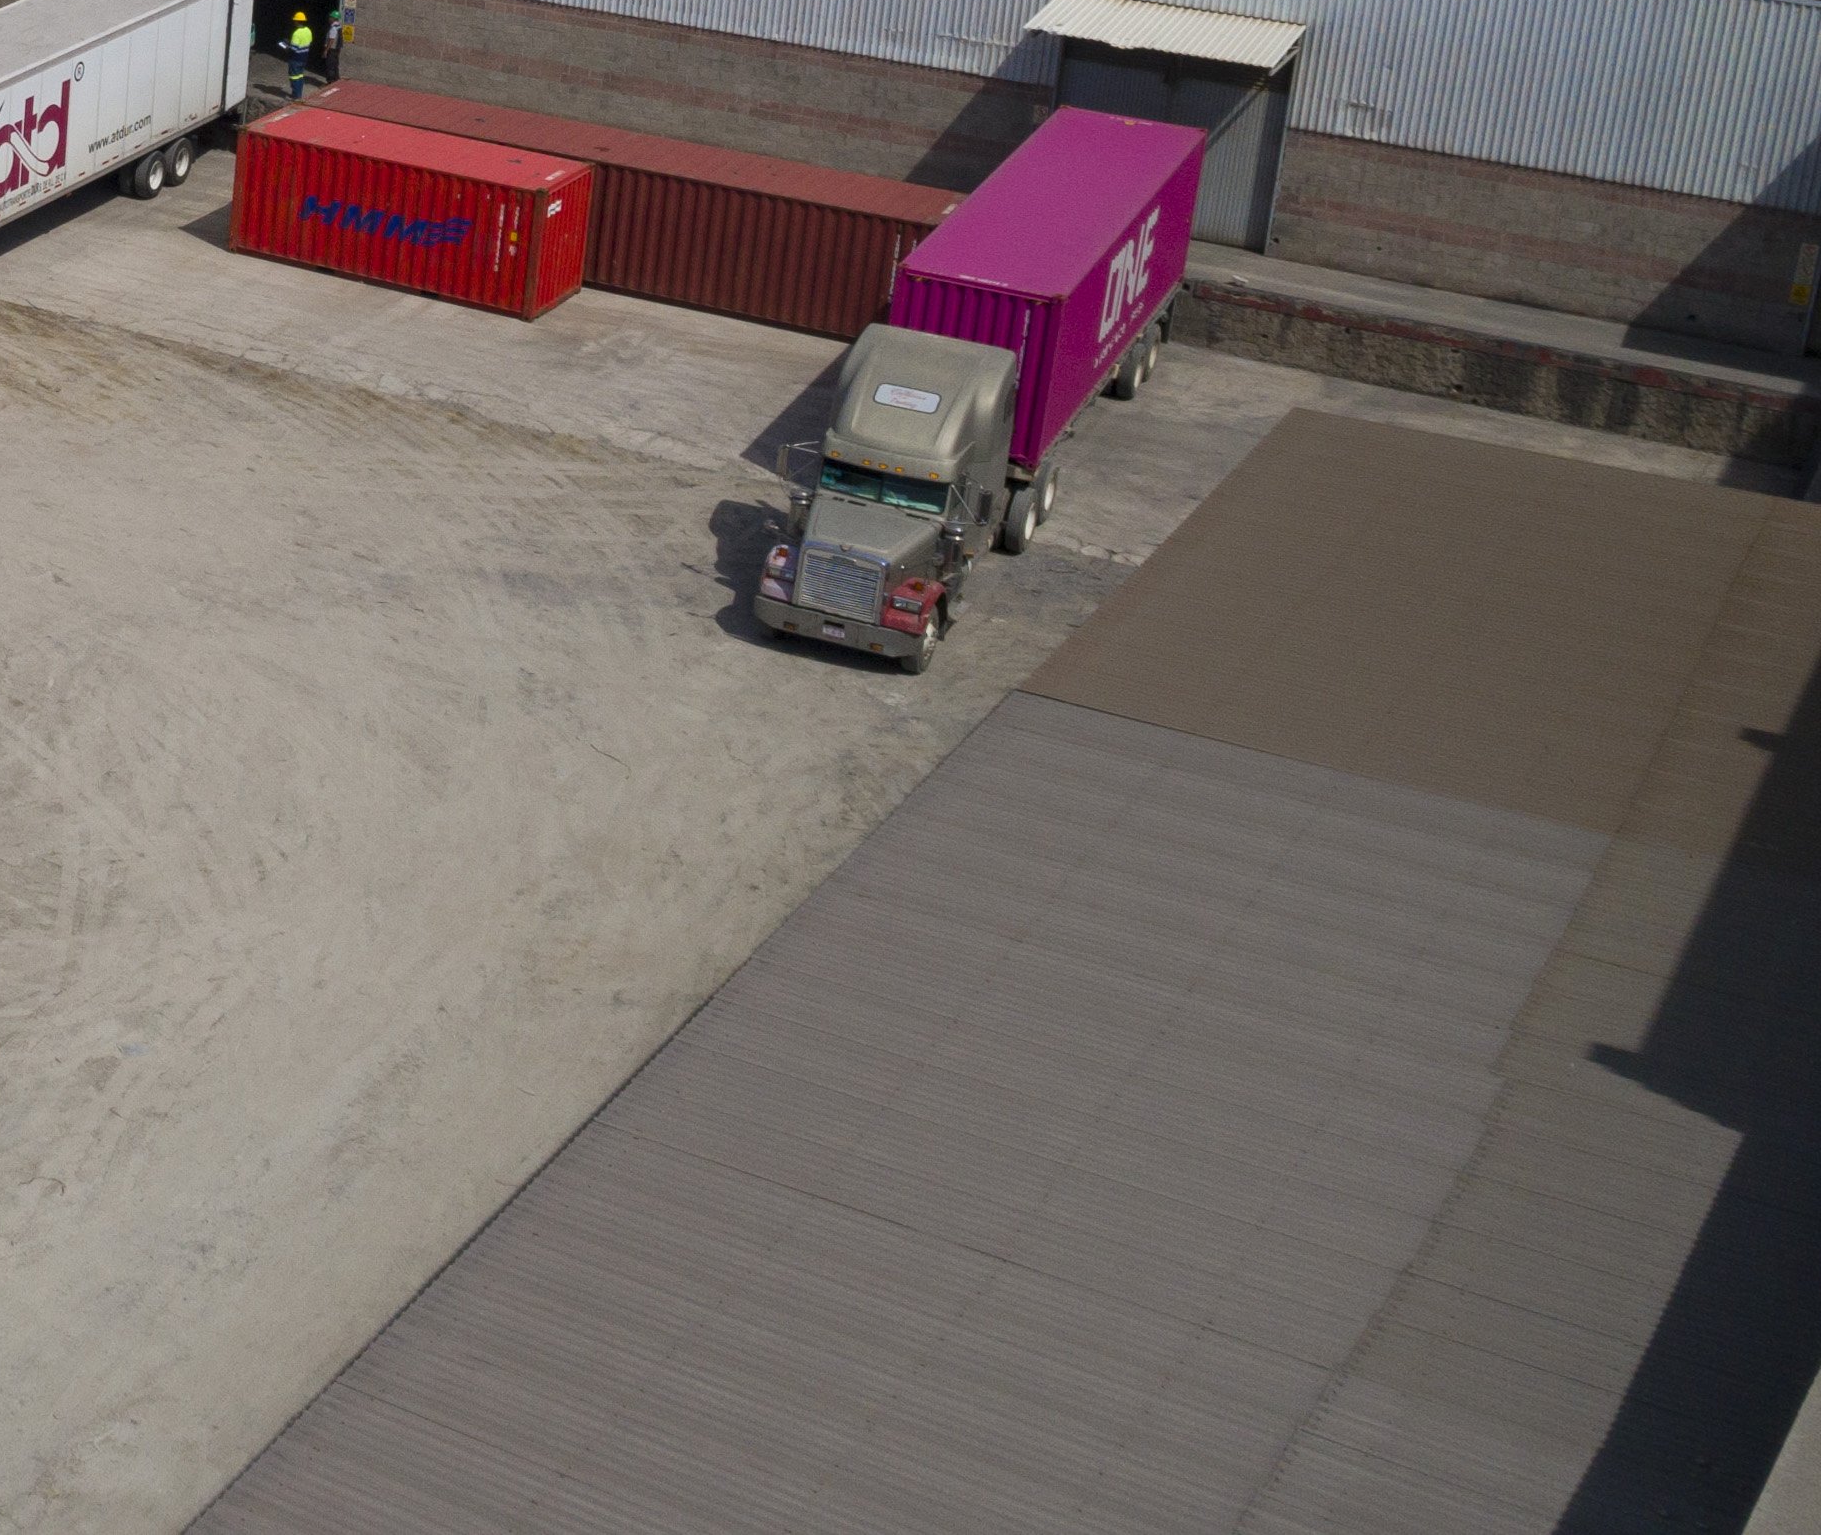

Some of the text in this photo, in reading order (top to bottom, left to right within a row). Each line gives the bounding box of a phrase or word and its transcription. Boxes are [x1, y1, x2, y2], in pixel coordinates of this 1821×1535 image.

[88, 115, 152, 154] www.atdur.com
[299, 195, 429, 246] HMM
[1098, 205, 1161, 343] ONE
